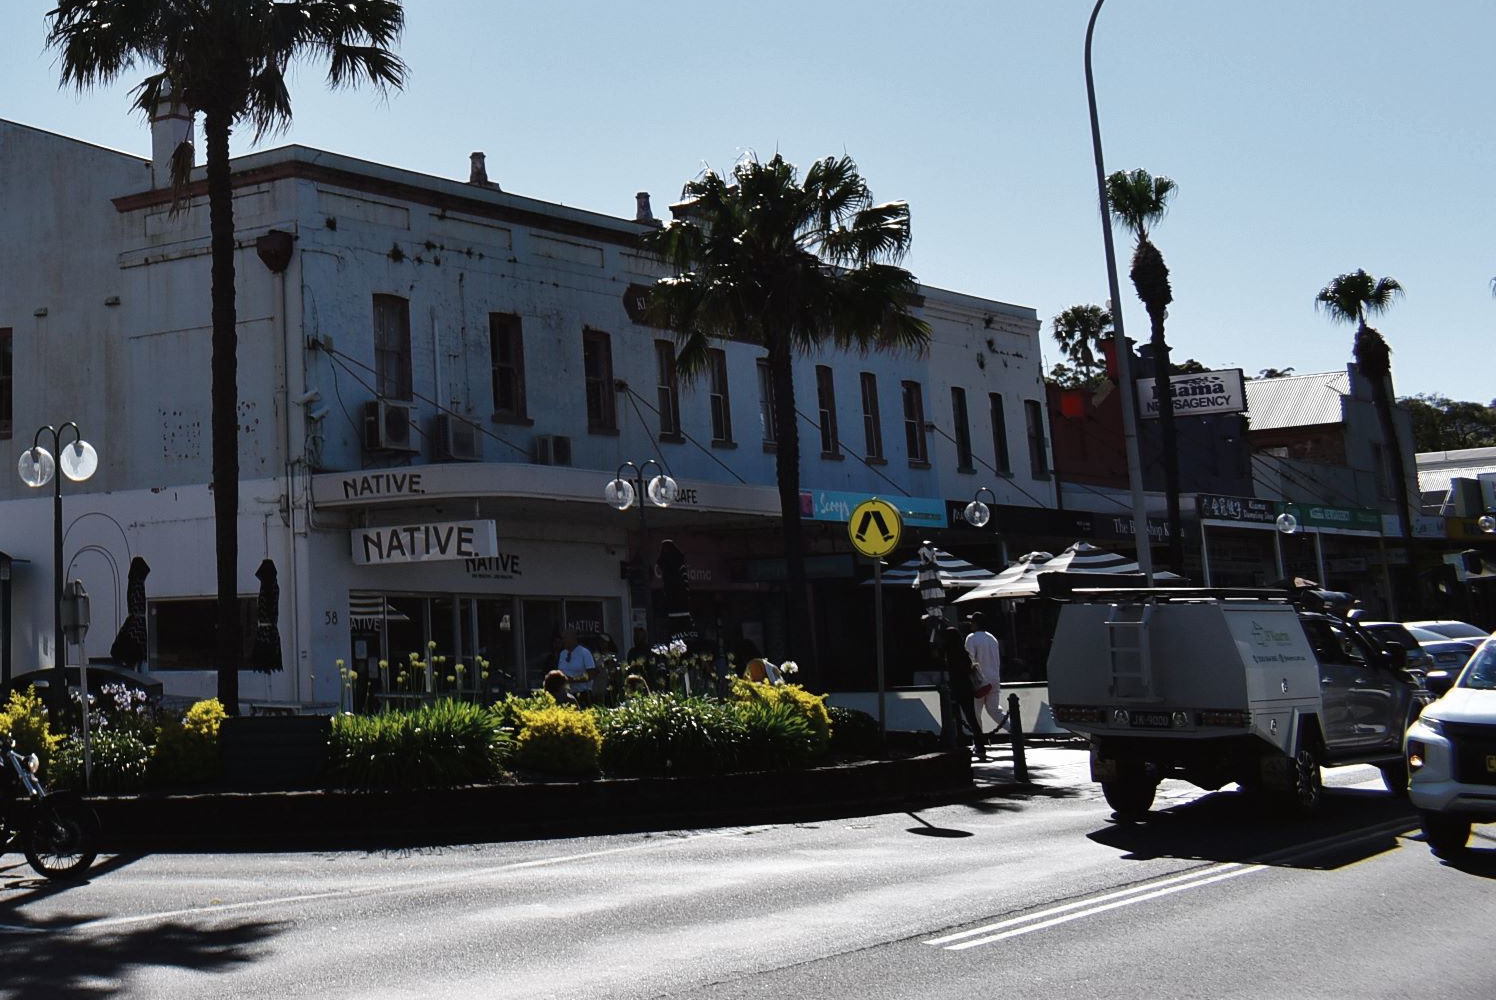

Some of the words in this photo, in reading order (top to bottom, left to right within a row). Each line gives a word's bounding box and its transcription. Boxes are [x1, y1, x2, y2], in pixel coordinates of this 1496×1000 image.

[1147, 395, 1231, 413] NESAGENCY
[342, 473, 425, 499] NATIVE.
[362, 525, 479, 563] NATIVE.
[325, 611, 338, 625] 58
[350, 616, 382, 632] ATIVE
[568, 619, 601, 633] NATIVE
